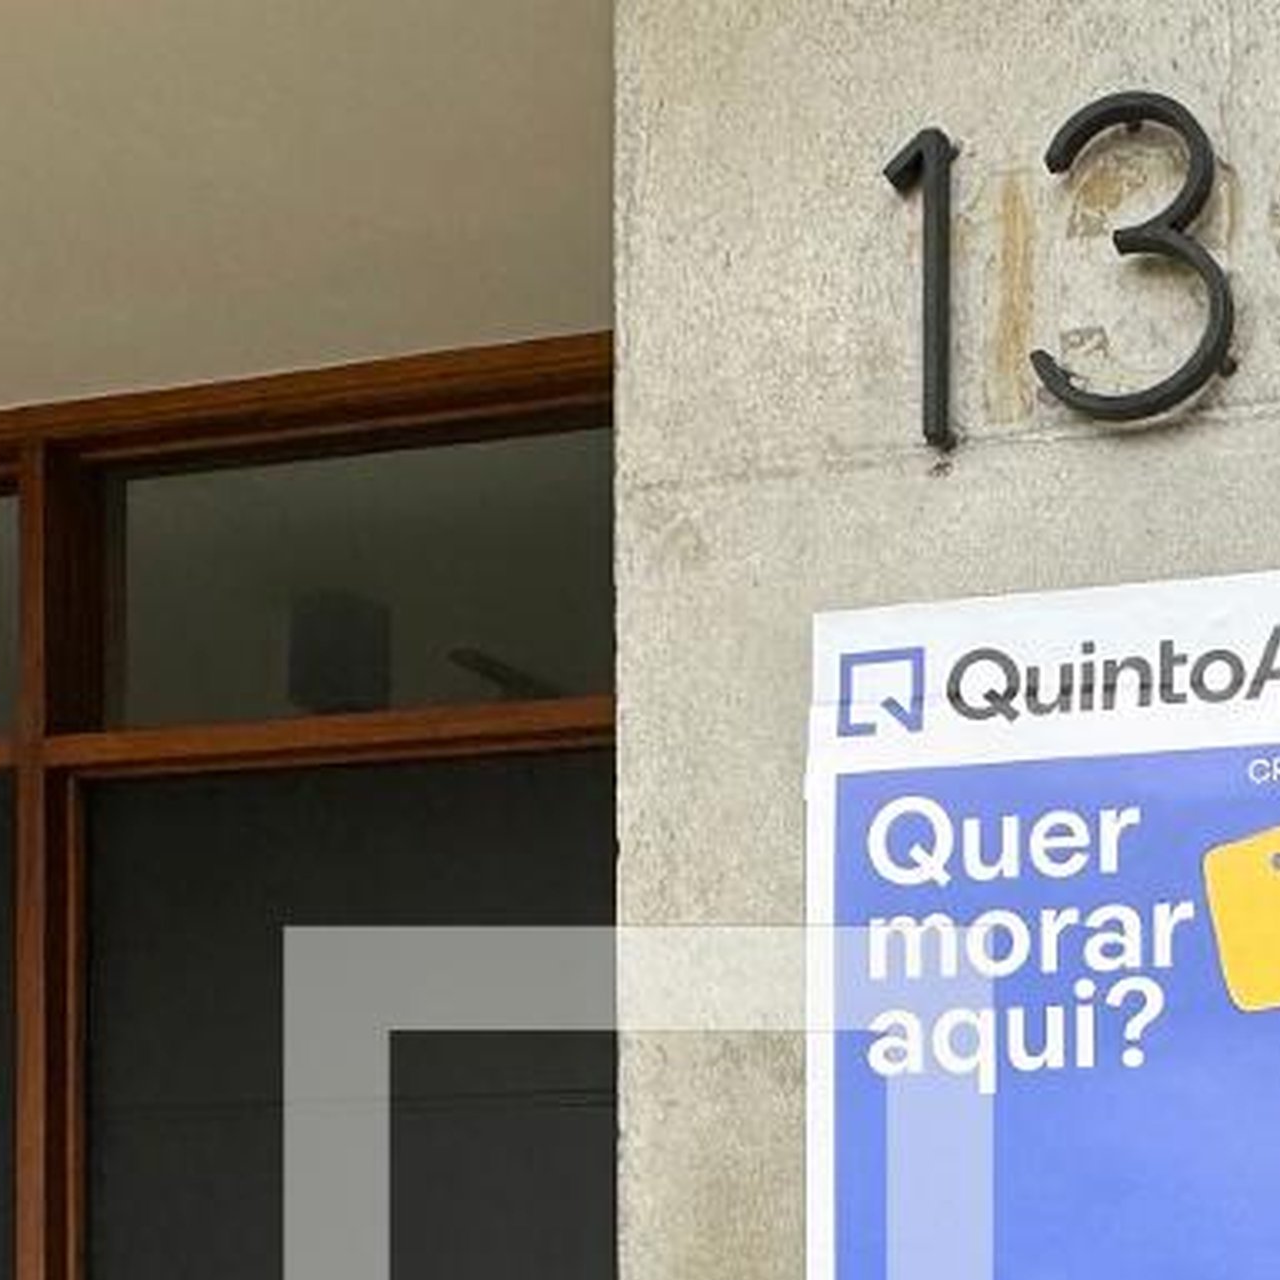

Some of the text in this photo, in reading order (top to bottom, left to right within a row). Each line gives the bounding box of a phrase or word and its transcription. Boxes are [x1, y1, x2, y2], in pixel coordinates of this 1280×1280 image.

[866, 796, 1141, 886] Quer
[867, 901, 1195, 979] morar
[866, 977, 1165, 1094] aqui?
